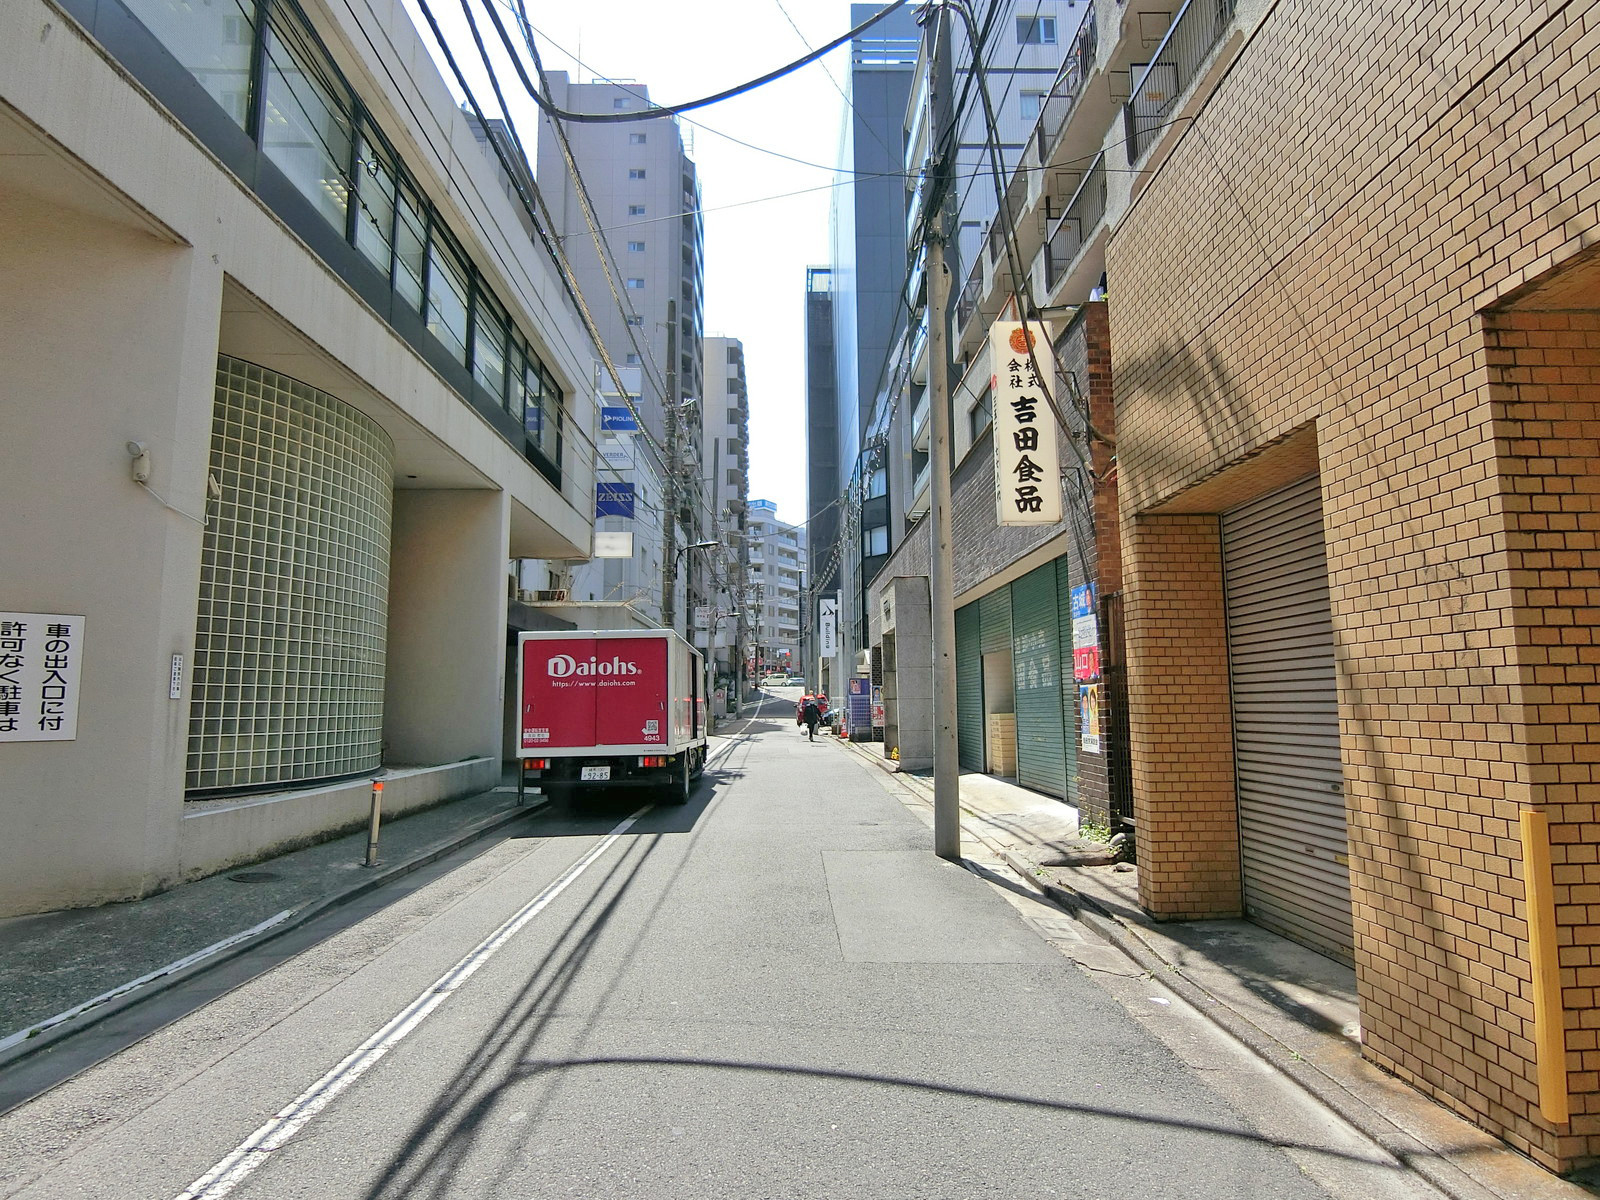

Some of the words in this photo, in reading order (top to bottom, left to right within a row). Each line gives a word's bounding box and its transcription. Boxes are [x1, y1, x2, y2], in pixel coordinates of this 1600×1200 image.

[1010, 395, 1044, 513] 吉田食品
[598, 492, 633, 502] ZEISS
[547, 654, 637, 678] Daiohs
[1074, 653, 1088, 670] 山口
[0, 621, 27, 732] 許可なく駐車は
[38, 623, 71, 731] 車の出入口に付
[552, 680, 636, 688] https://www.daiohs.com
[587, 771, 609, 780] 92-85
